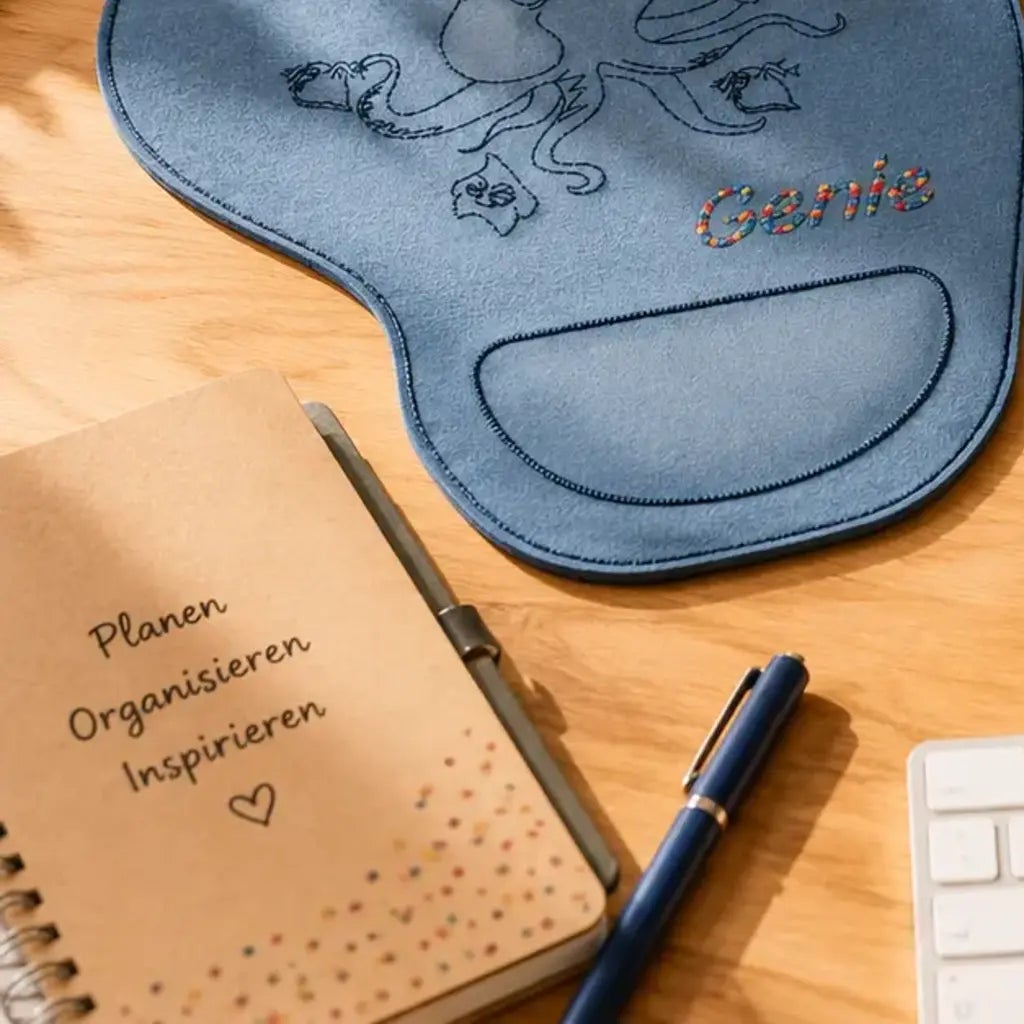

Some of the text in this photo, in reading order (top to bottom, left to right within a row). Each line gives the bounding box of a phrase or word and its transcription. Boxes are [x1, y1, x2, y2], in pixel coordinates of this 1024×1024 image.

[695, 152, 935, 248] Genie
[88, 598, 227, 659] Planen
[69, 636, 311, 742] Organisieren
[121, 700, 326, 793] Inspirieren
